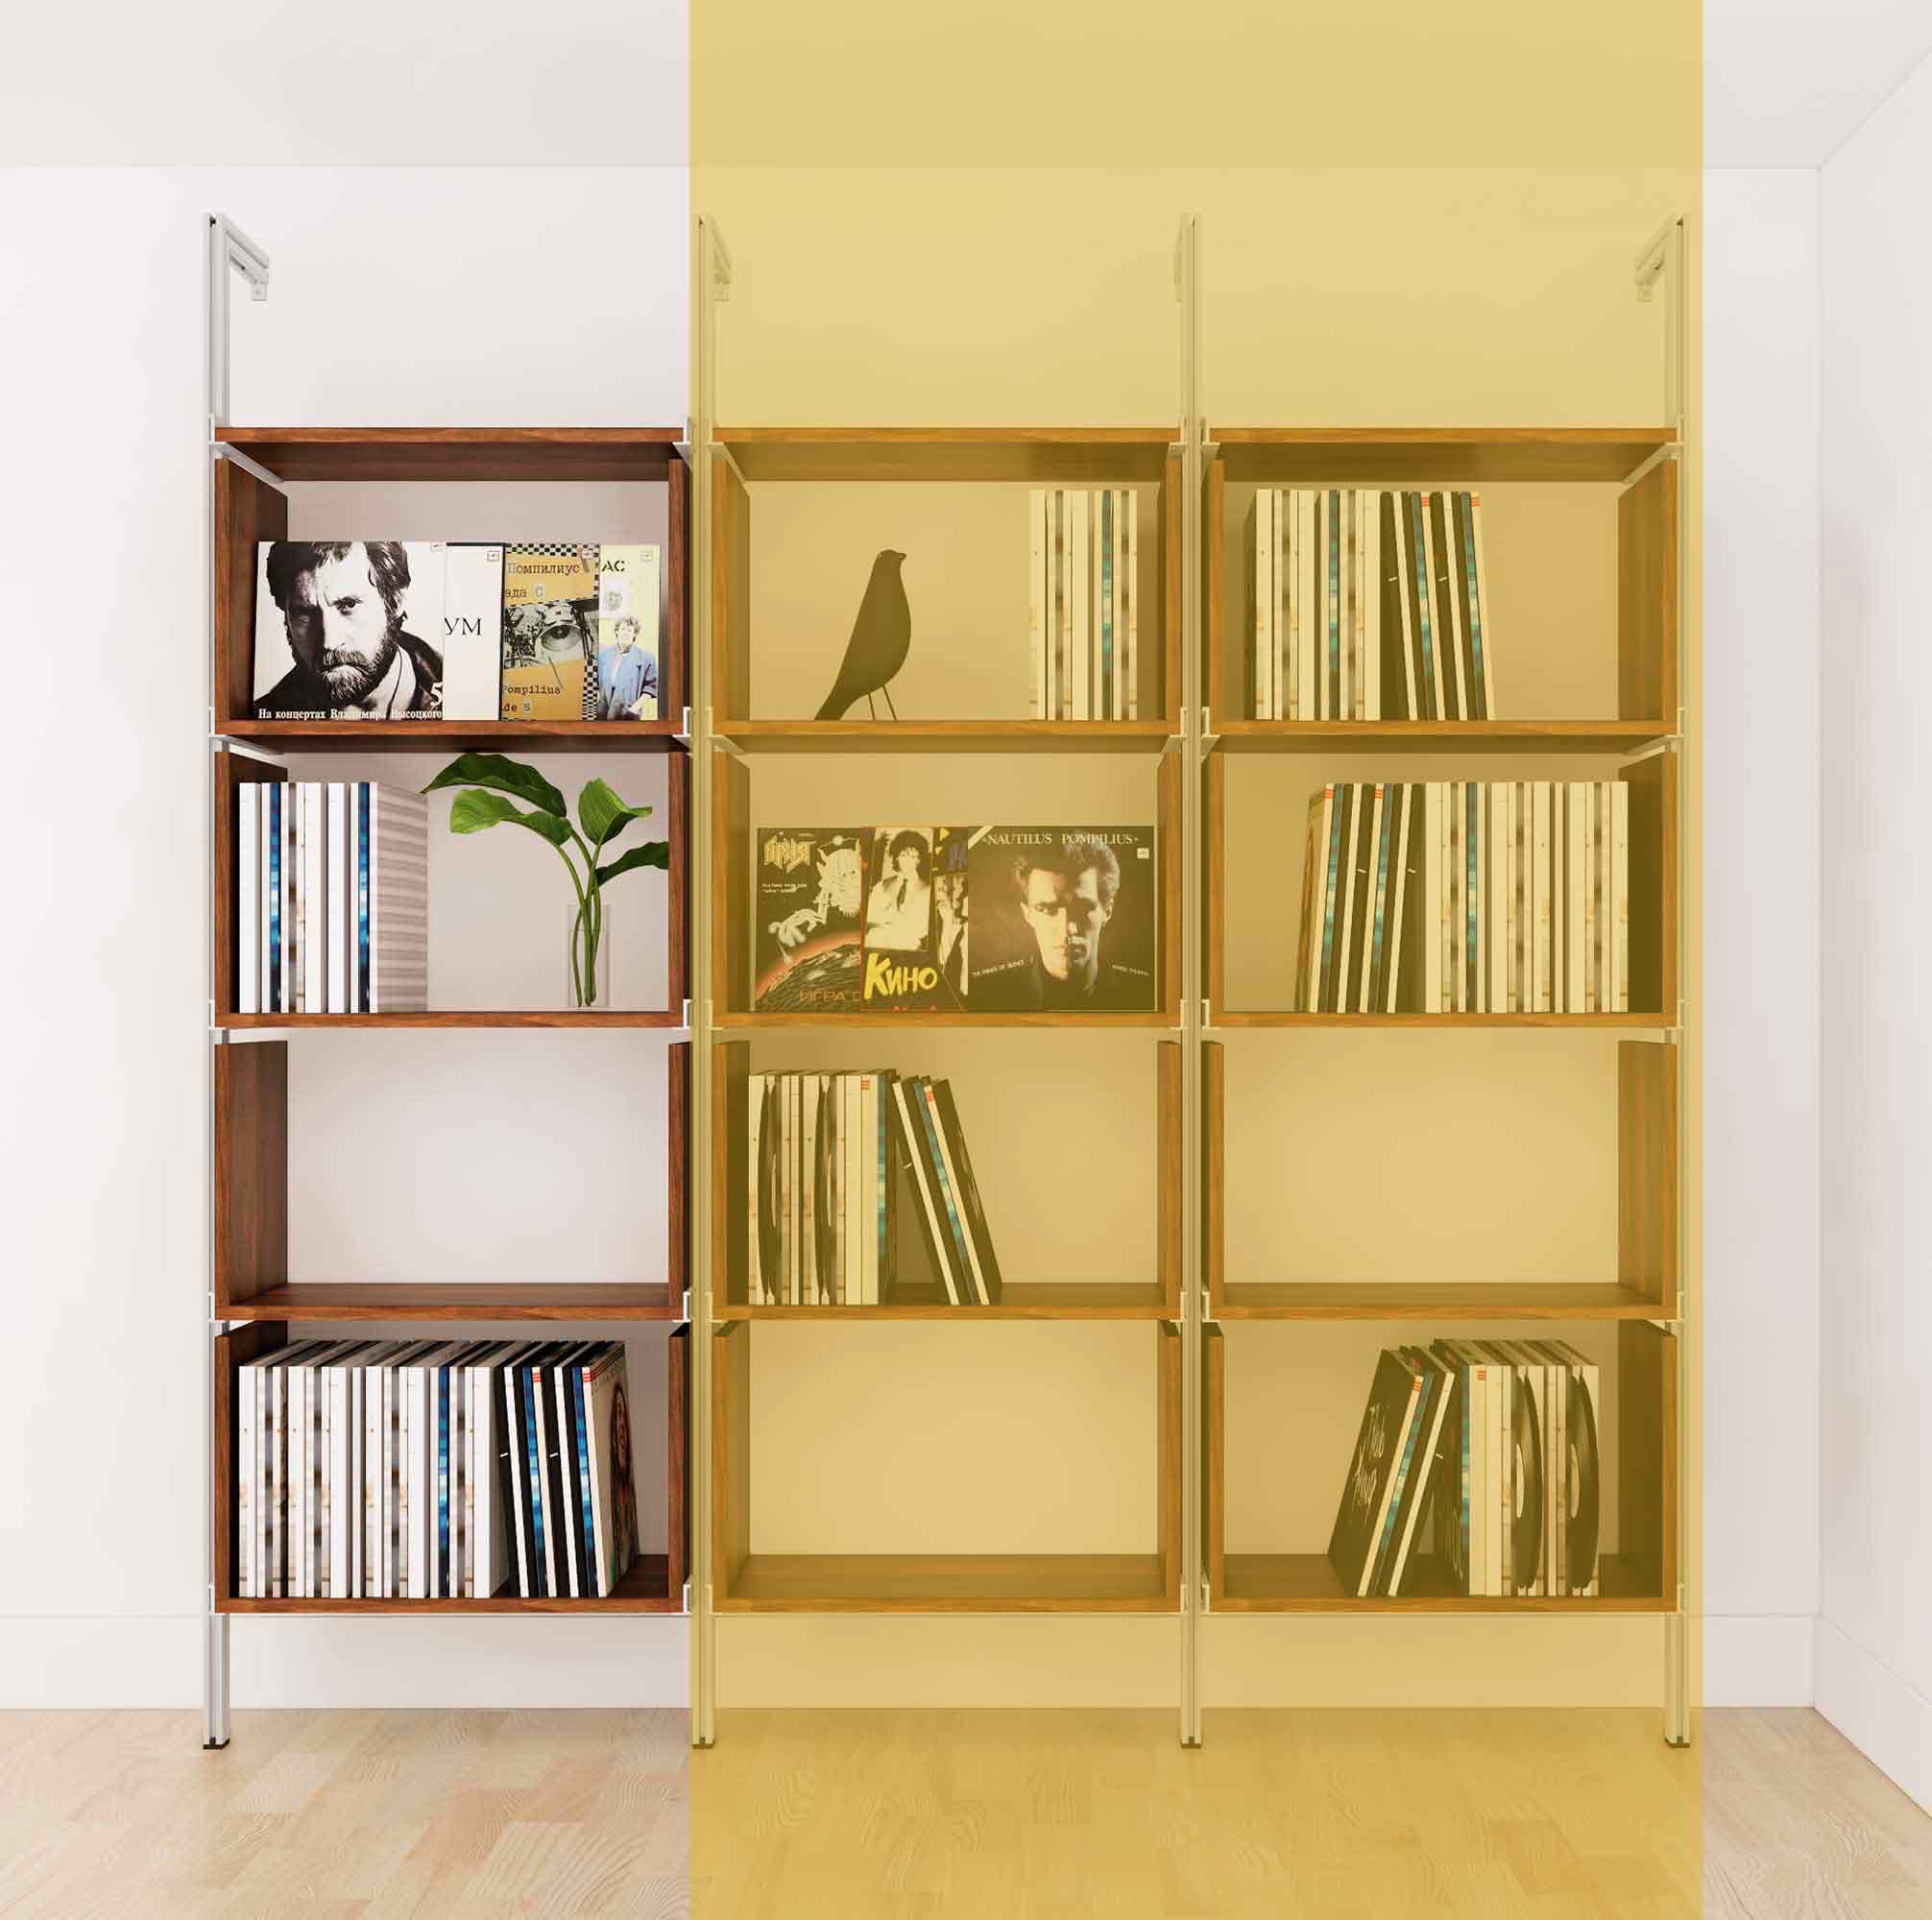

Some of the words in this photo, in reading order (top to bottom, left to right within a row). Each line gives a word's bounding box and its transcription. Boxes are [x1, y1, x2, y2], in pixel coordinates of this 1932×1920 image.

[506, 563, 580, 576] Помпилиус
[444, 617, 482, 636] УМ
[430, 682, 443, 706] 5
[258, 708, 272, 719] На
[276, 708, 326, 720] концертах
